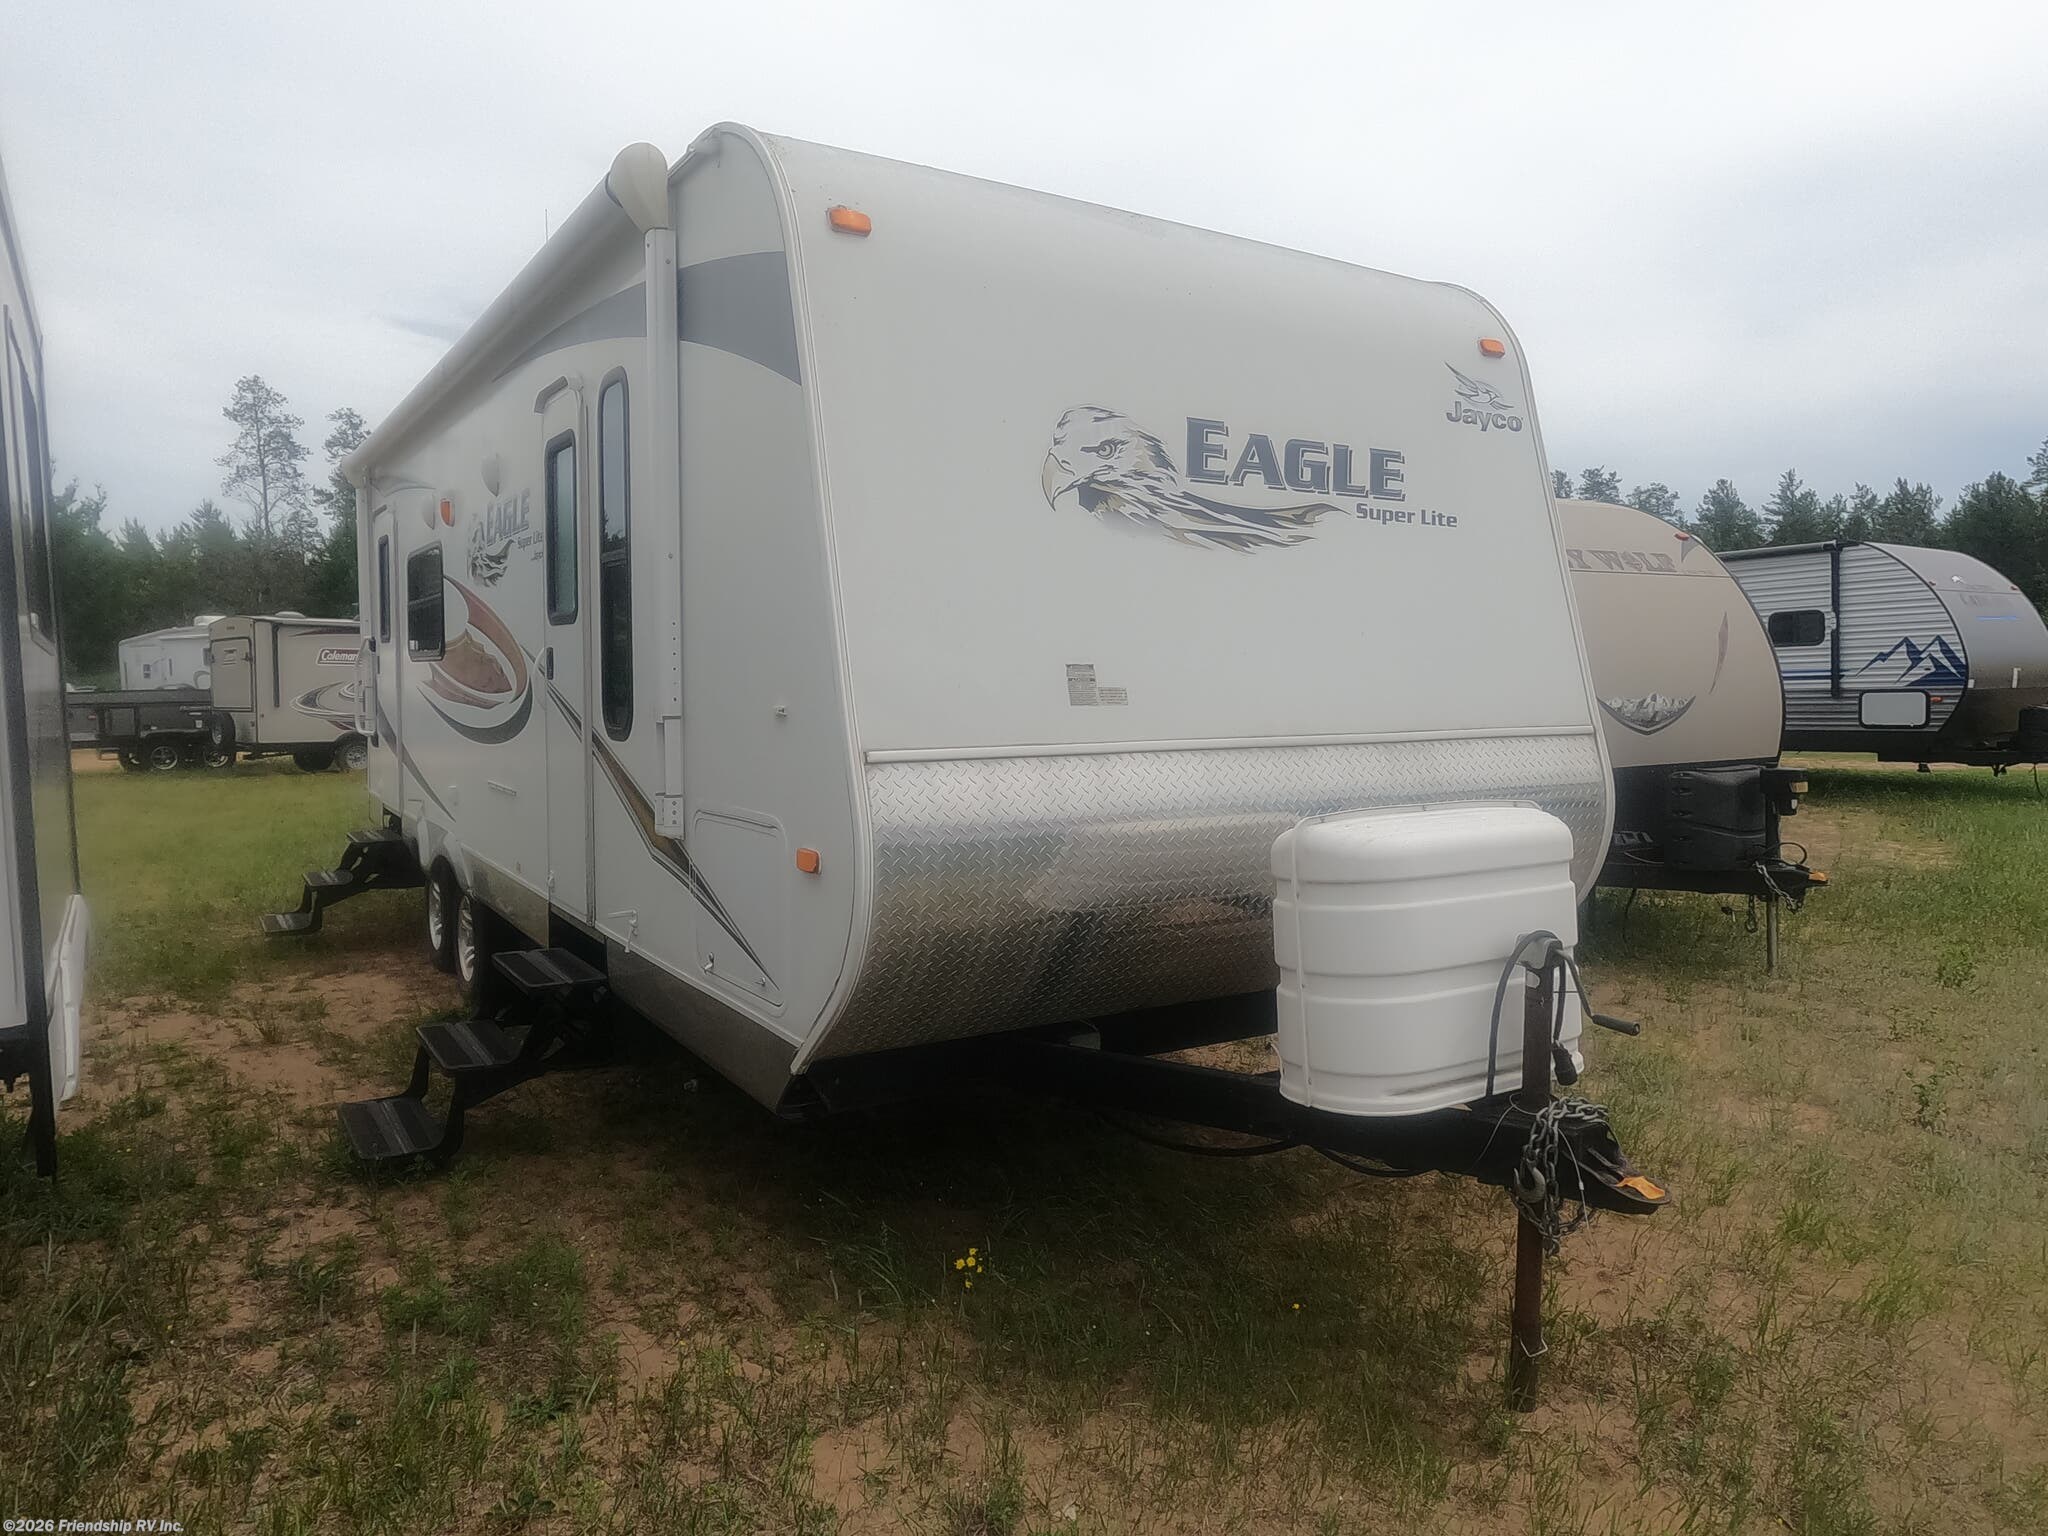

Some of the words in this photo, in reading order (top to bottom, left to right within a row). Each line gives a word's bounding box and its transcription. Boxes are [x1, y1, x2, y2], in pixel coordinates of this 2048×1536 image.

[1446, 400, 1523, 432] Jayco
[1186, 416, 1406, 502] EAGLE
[486, 488, 530, 547] EAGLE
[1356, 502, 1416, 526] Super
[1420, 508, 1458, 528] Lite
[321, 649, 360, 661] Coleman
